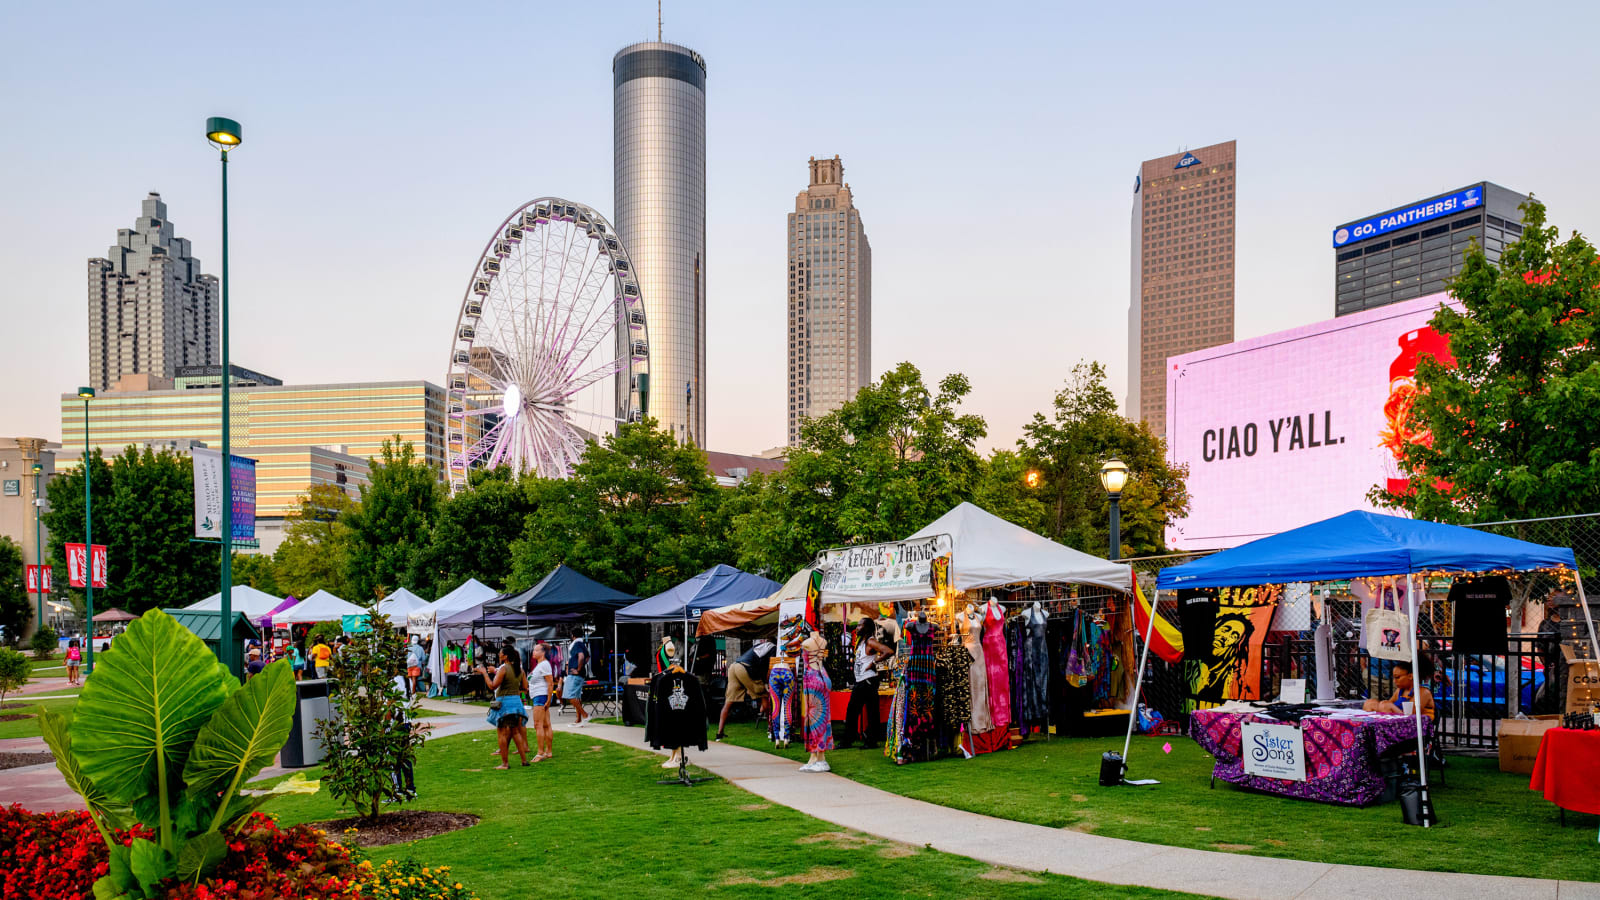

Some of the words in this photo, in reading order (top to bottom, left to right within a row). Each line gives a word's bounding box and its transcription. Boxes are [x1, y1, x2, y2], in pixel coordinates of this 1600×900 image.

[1181, 157, 1195, 166] GP
[1353, 223, 1376, 237] GO,
[1380, 198, 1457, 229] PANTHERS!
[1202, 422, 1258, 462] CIAO
[1269, 410, 1345, 453] Y'ALL.
[1233, 584, 1282, 606] LOVE
[1573, 675, 1600, 684] COS
